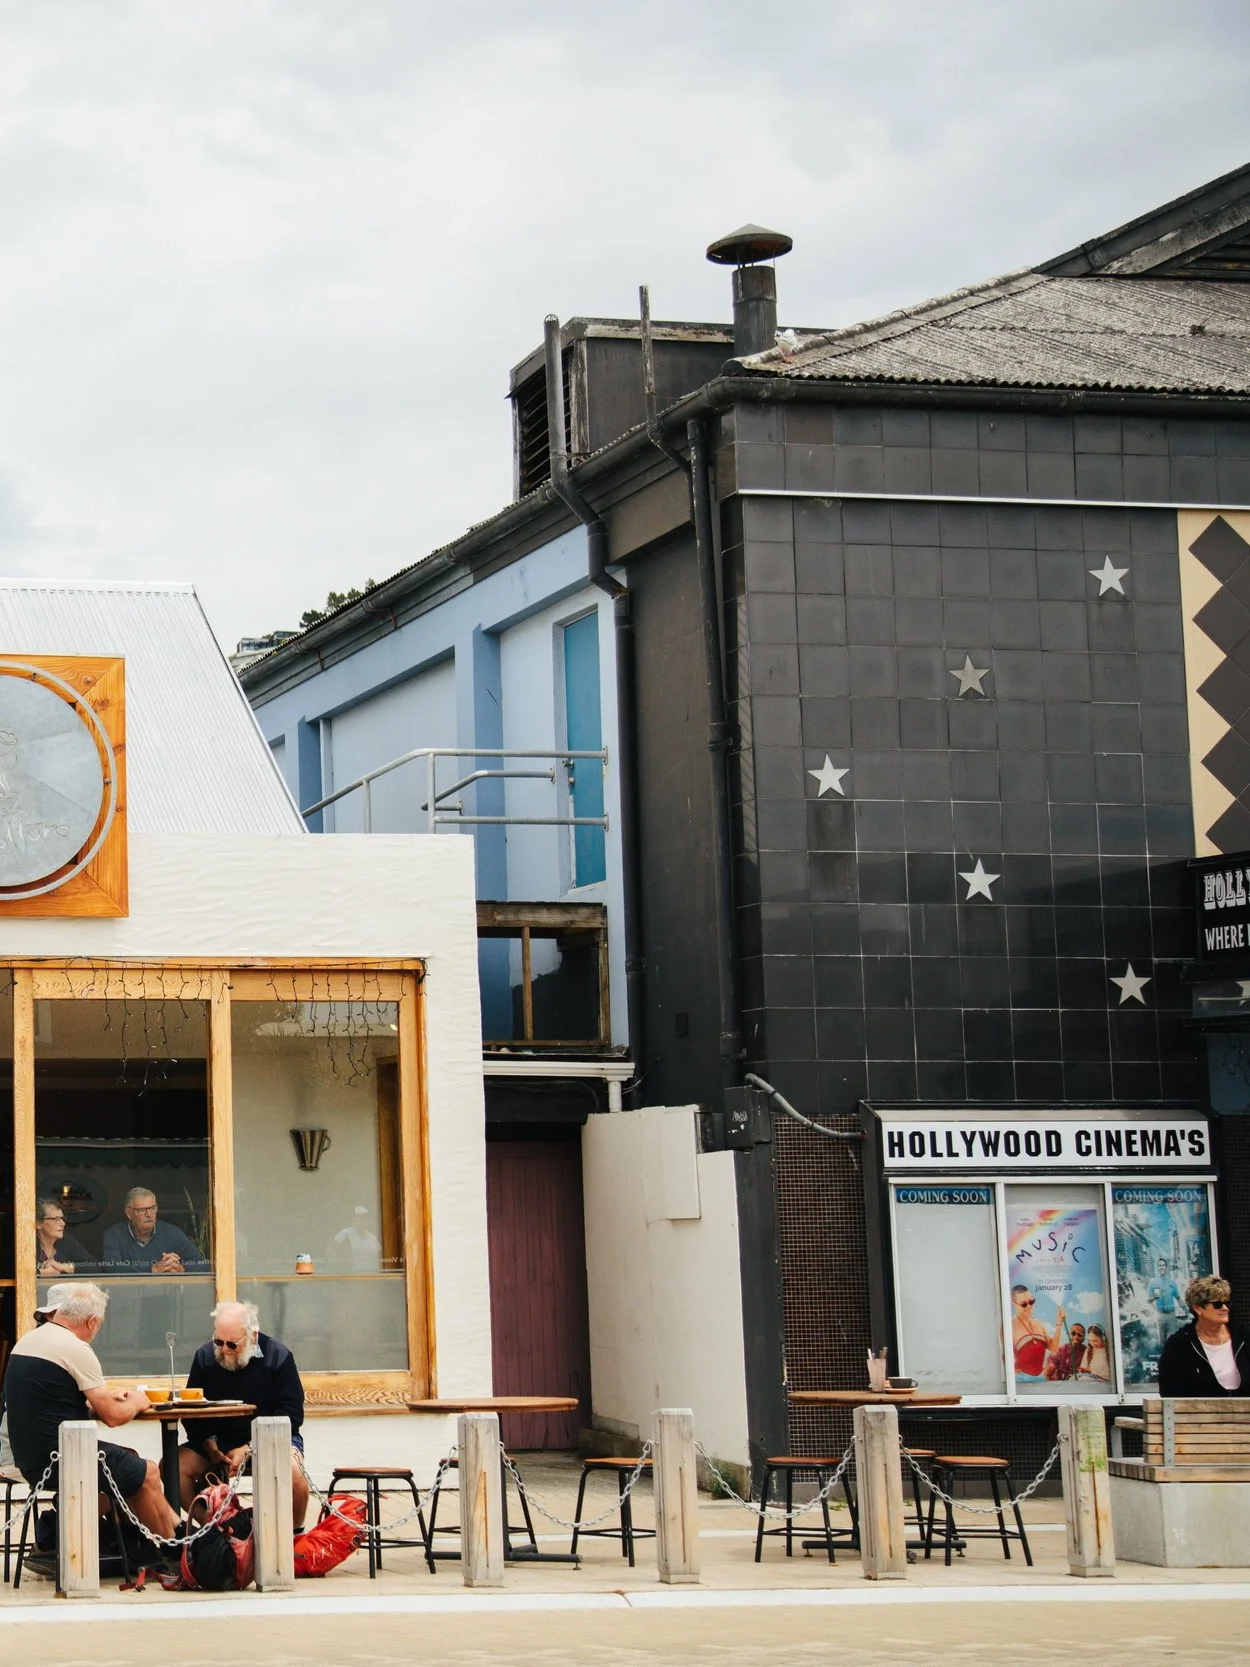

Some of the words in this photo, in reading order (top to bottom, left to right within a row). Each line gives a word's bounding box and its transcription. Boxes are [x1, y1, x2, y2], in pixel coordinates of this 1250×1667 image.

[1204, 924, 1245, 951] WHERE
[887, 1130, 1062, 1158] HOLLYWOOD
[1075, 1129, 1206, 1157] CINEMA'S
[899, 1190, 950, 1203] COMING
[952, 1190, 987, 1203] SOON
[1115, 1190, 1164, 1202] COMING
[1167, 1190, 1202, 1202] SOON
[1035, 1284, 1062, 1292] january
[1142, 1361, 1159, 1371] FR
